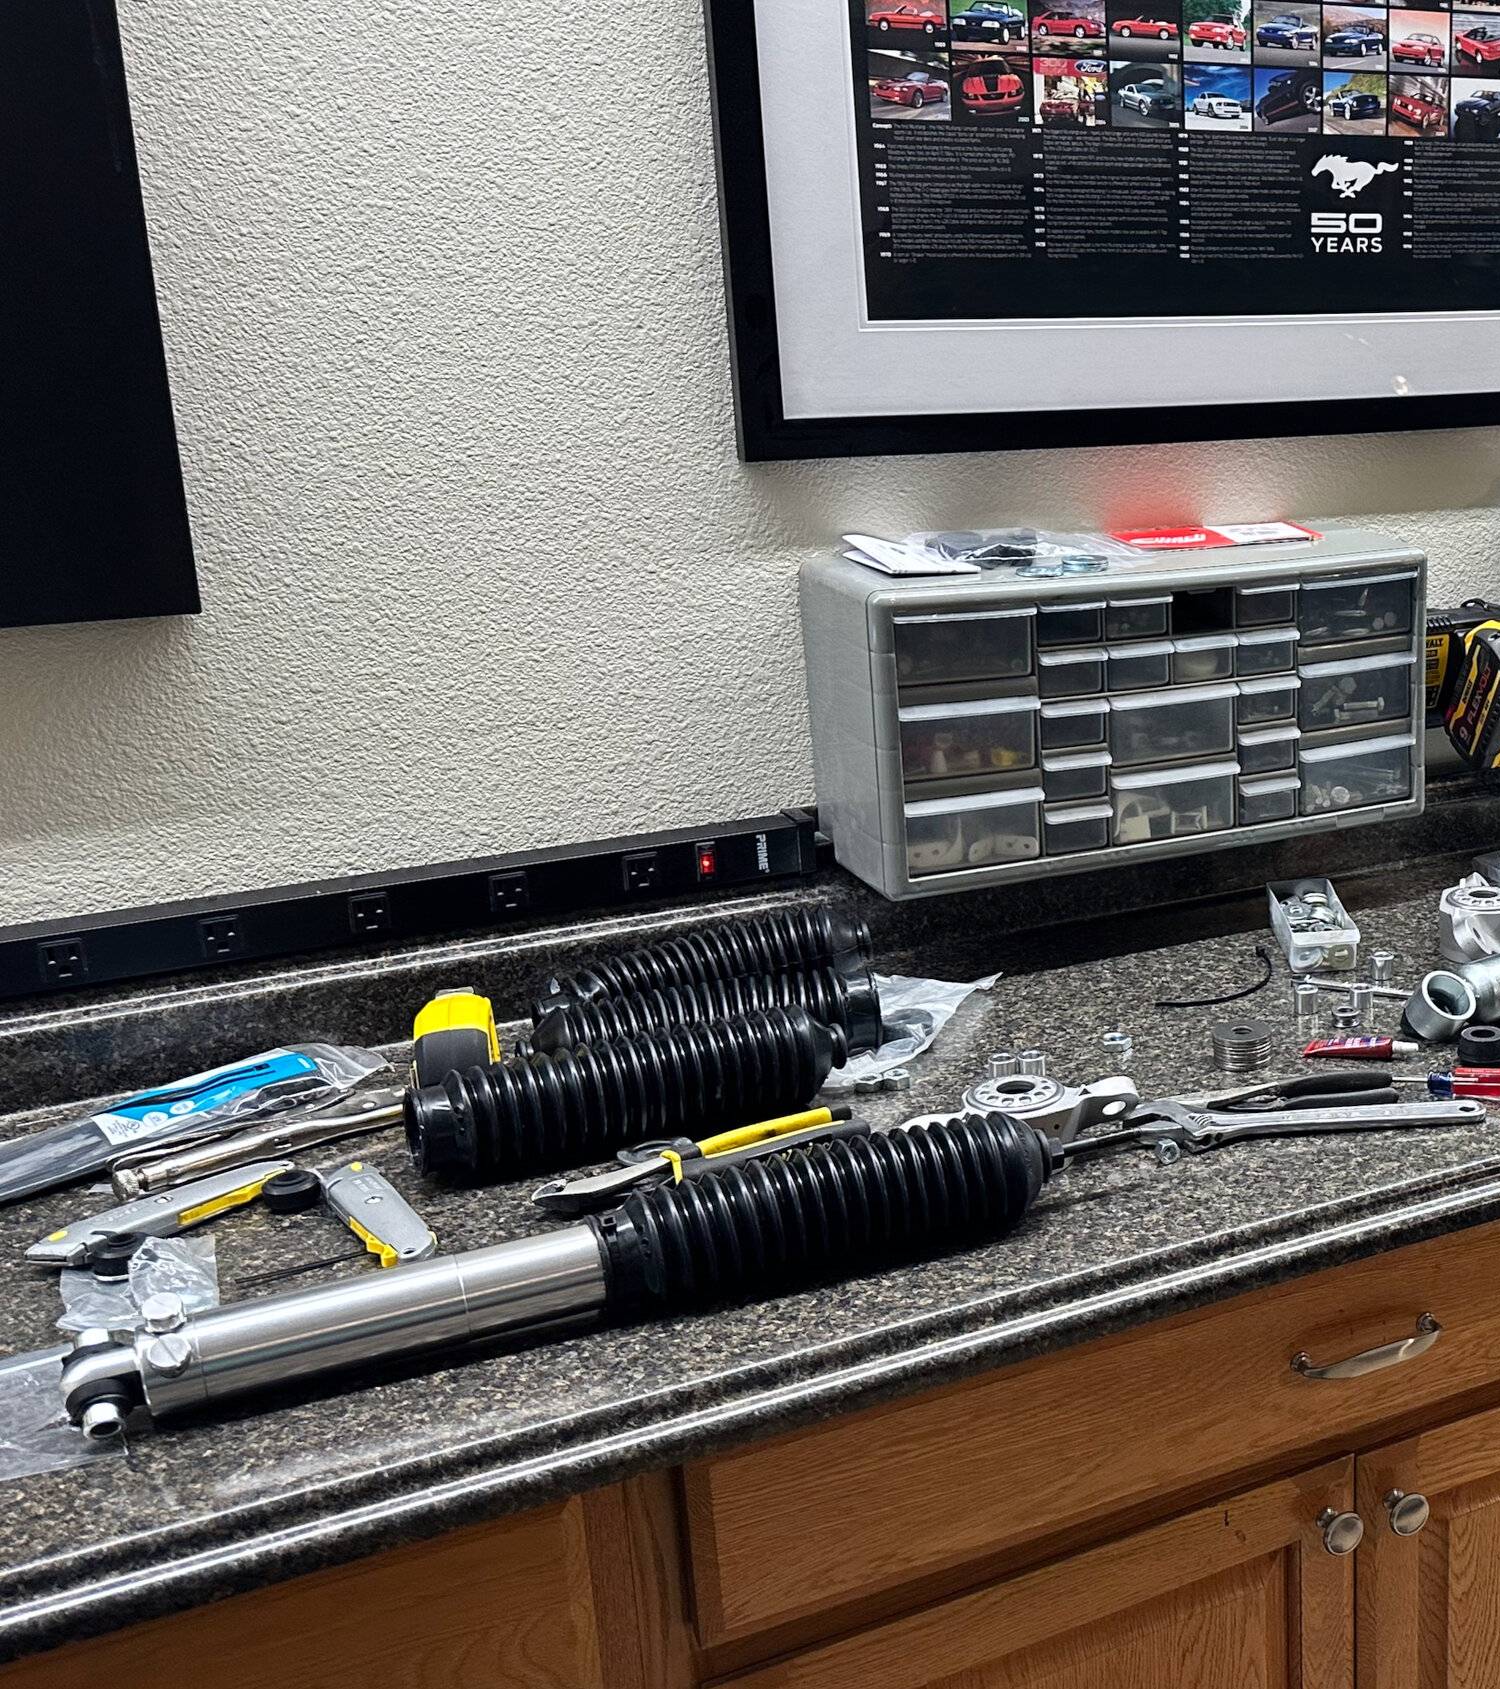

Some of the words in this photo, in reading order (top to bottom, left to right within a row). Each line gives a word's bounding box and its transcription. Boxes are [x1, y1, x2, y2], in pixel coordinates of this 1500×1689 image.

[1081, 63, 1104, 73] Ford
[1311, 212, 1382, 233] 50
[1311, 237, 1383, 253] YEARS
[1467, 664, 1492, 725] FLEXVOLT
[755, 833, 769, 872] PRIME
